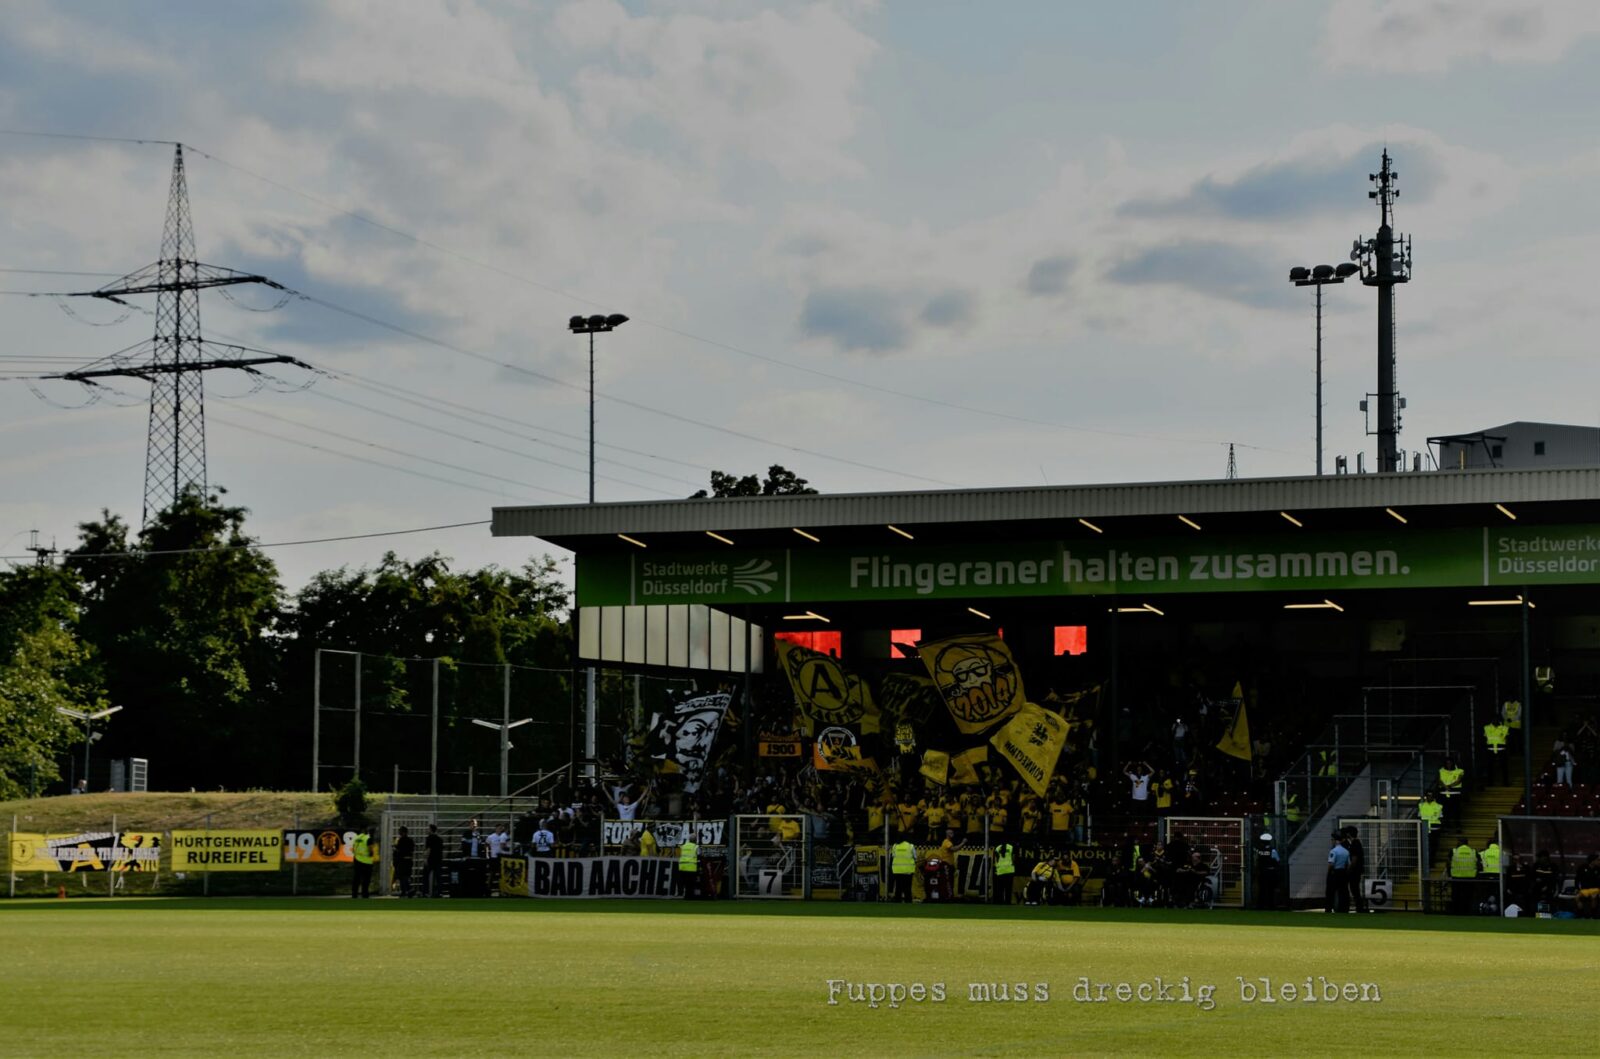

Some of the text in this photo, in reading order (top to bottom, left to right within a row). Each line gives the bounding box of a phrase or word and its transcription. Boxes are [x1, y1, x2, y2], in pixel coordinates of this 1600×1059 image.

[1498, 536, 1600, 553] Stadtwerk
[642, 561, 728, 576] Stadtwerke
[850, 549, 1411, 594] Flingeraner halten zusammen.
[1498, 556, 1600, 574] Düsseldor
[642, 579, 728, 595] Düsseldorf
[174, 835, 279, 848] HÜRTGENWALD
[187, 851, 268, 864] RUREIFEL
[534, 860, 583, 895] BAD
[763, 871, 778, 894] 7
[1371, 881, 1387, 906] 5
